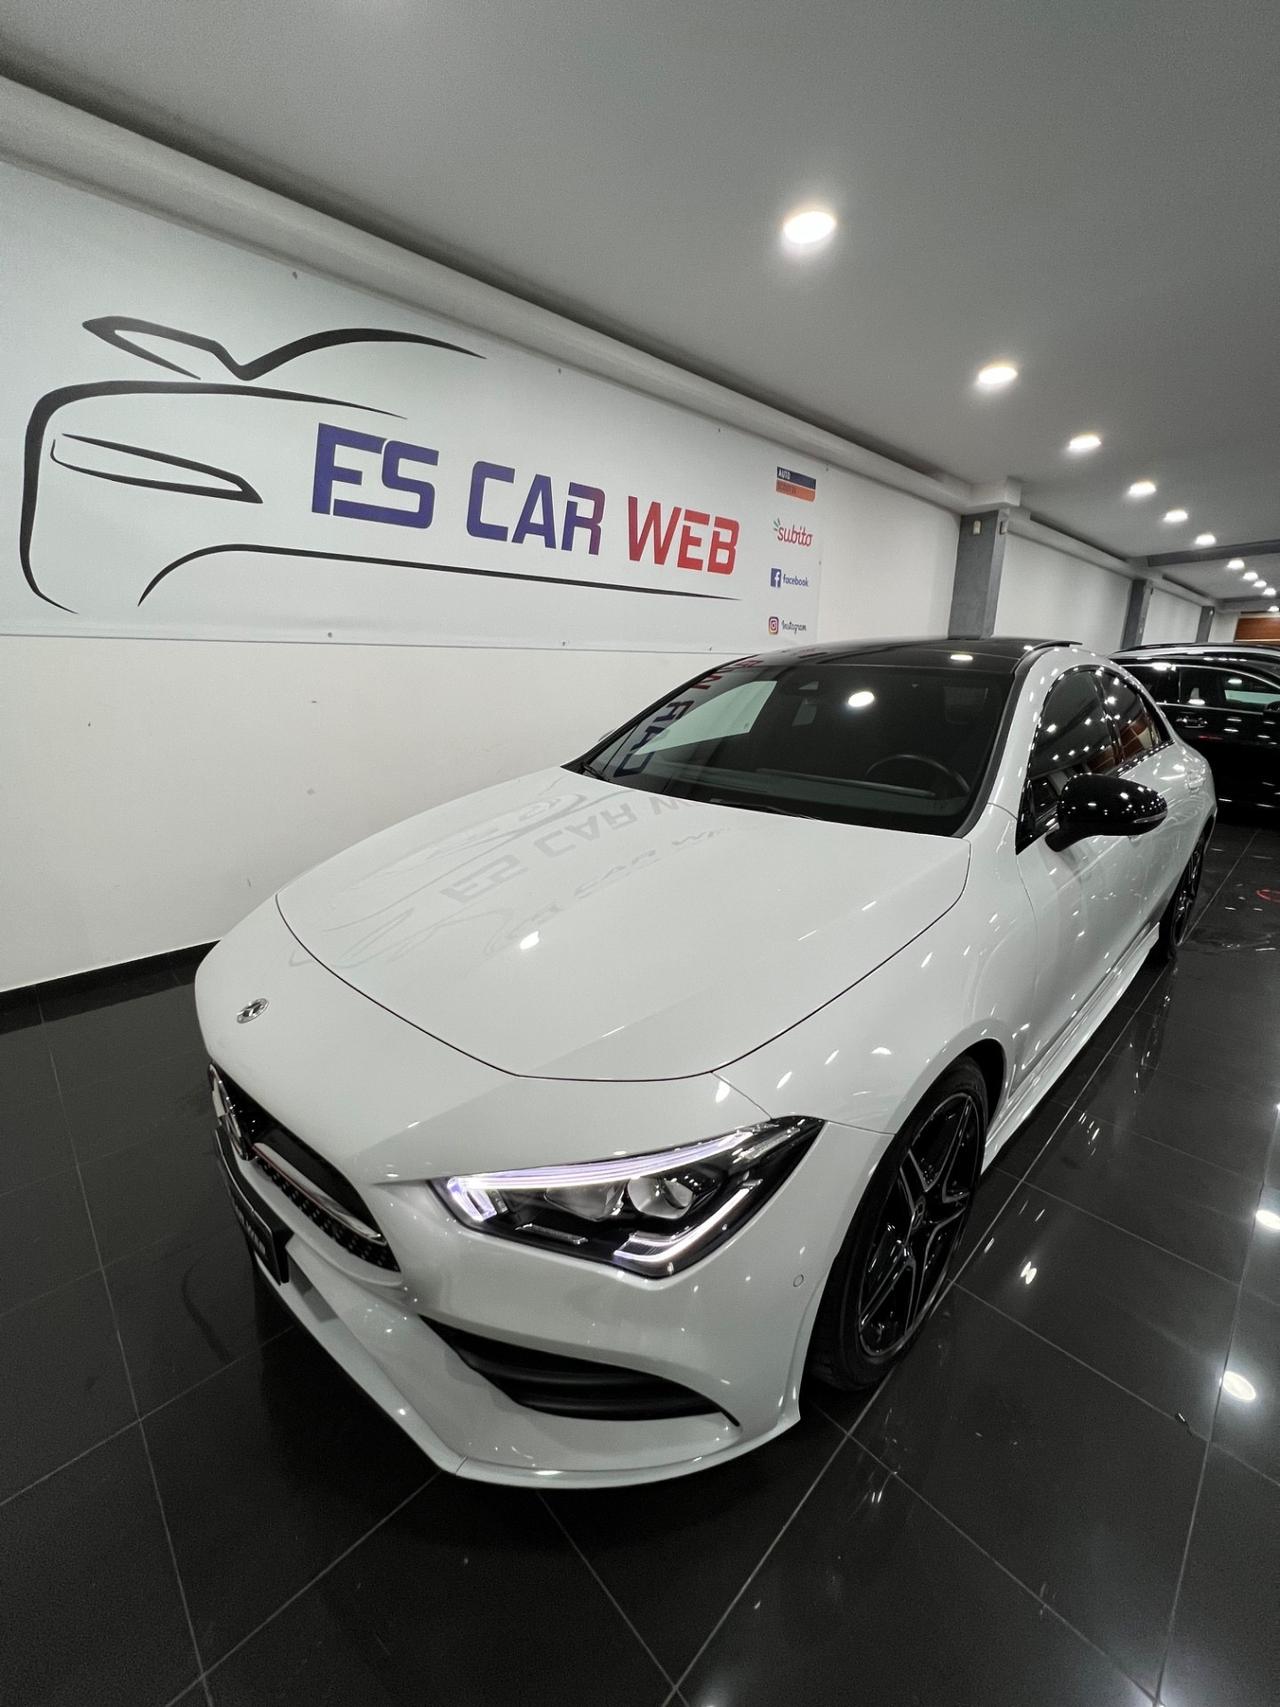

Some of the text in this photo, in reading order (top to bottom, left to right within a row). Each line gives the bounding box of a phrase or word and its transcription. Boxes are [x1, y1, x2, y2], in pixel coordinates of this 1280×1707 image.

[312, 423, 741, 575] ES CAR WEB
[777, 524, 813, 547] subito
[783, 574, 809, 587] facebook
